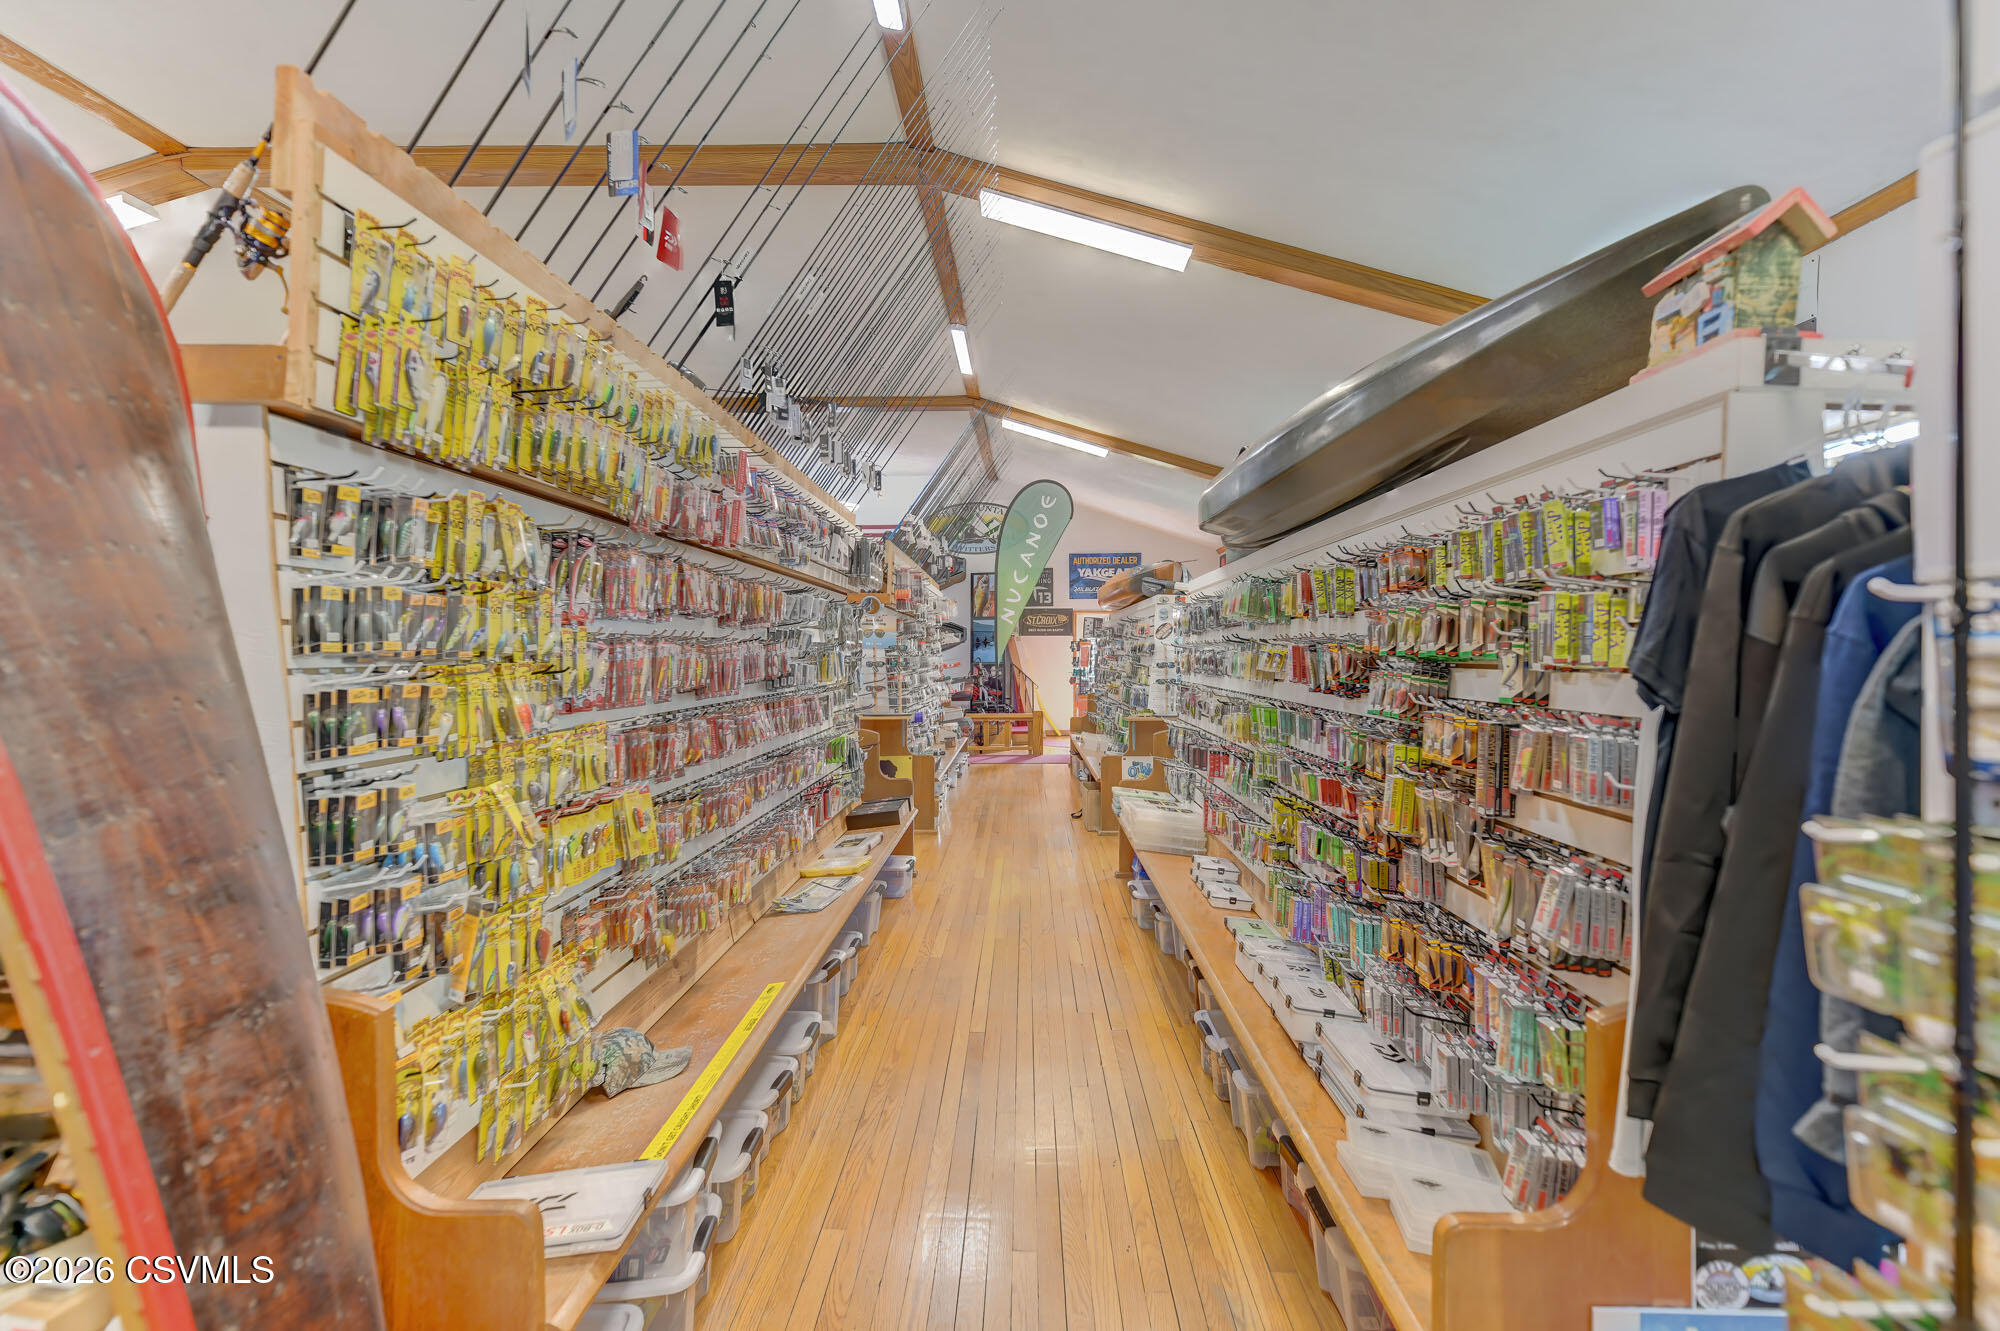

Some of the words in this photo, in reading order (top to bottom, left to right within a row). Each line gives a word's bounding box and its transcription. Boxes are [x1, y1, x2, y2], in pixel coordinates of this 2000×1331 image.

[1001, 495, 1057, 625] NUCANOE
[1073, 557, 1111, 565] AUTHORIZED
[1112, 556, 1138, 564] DEALER
[1038, 592, 1052, 604] 13
